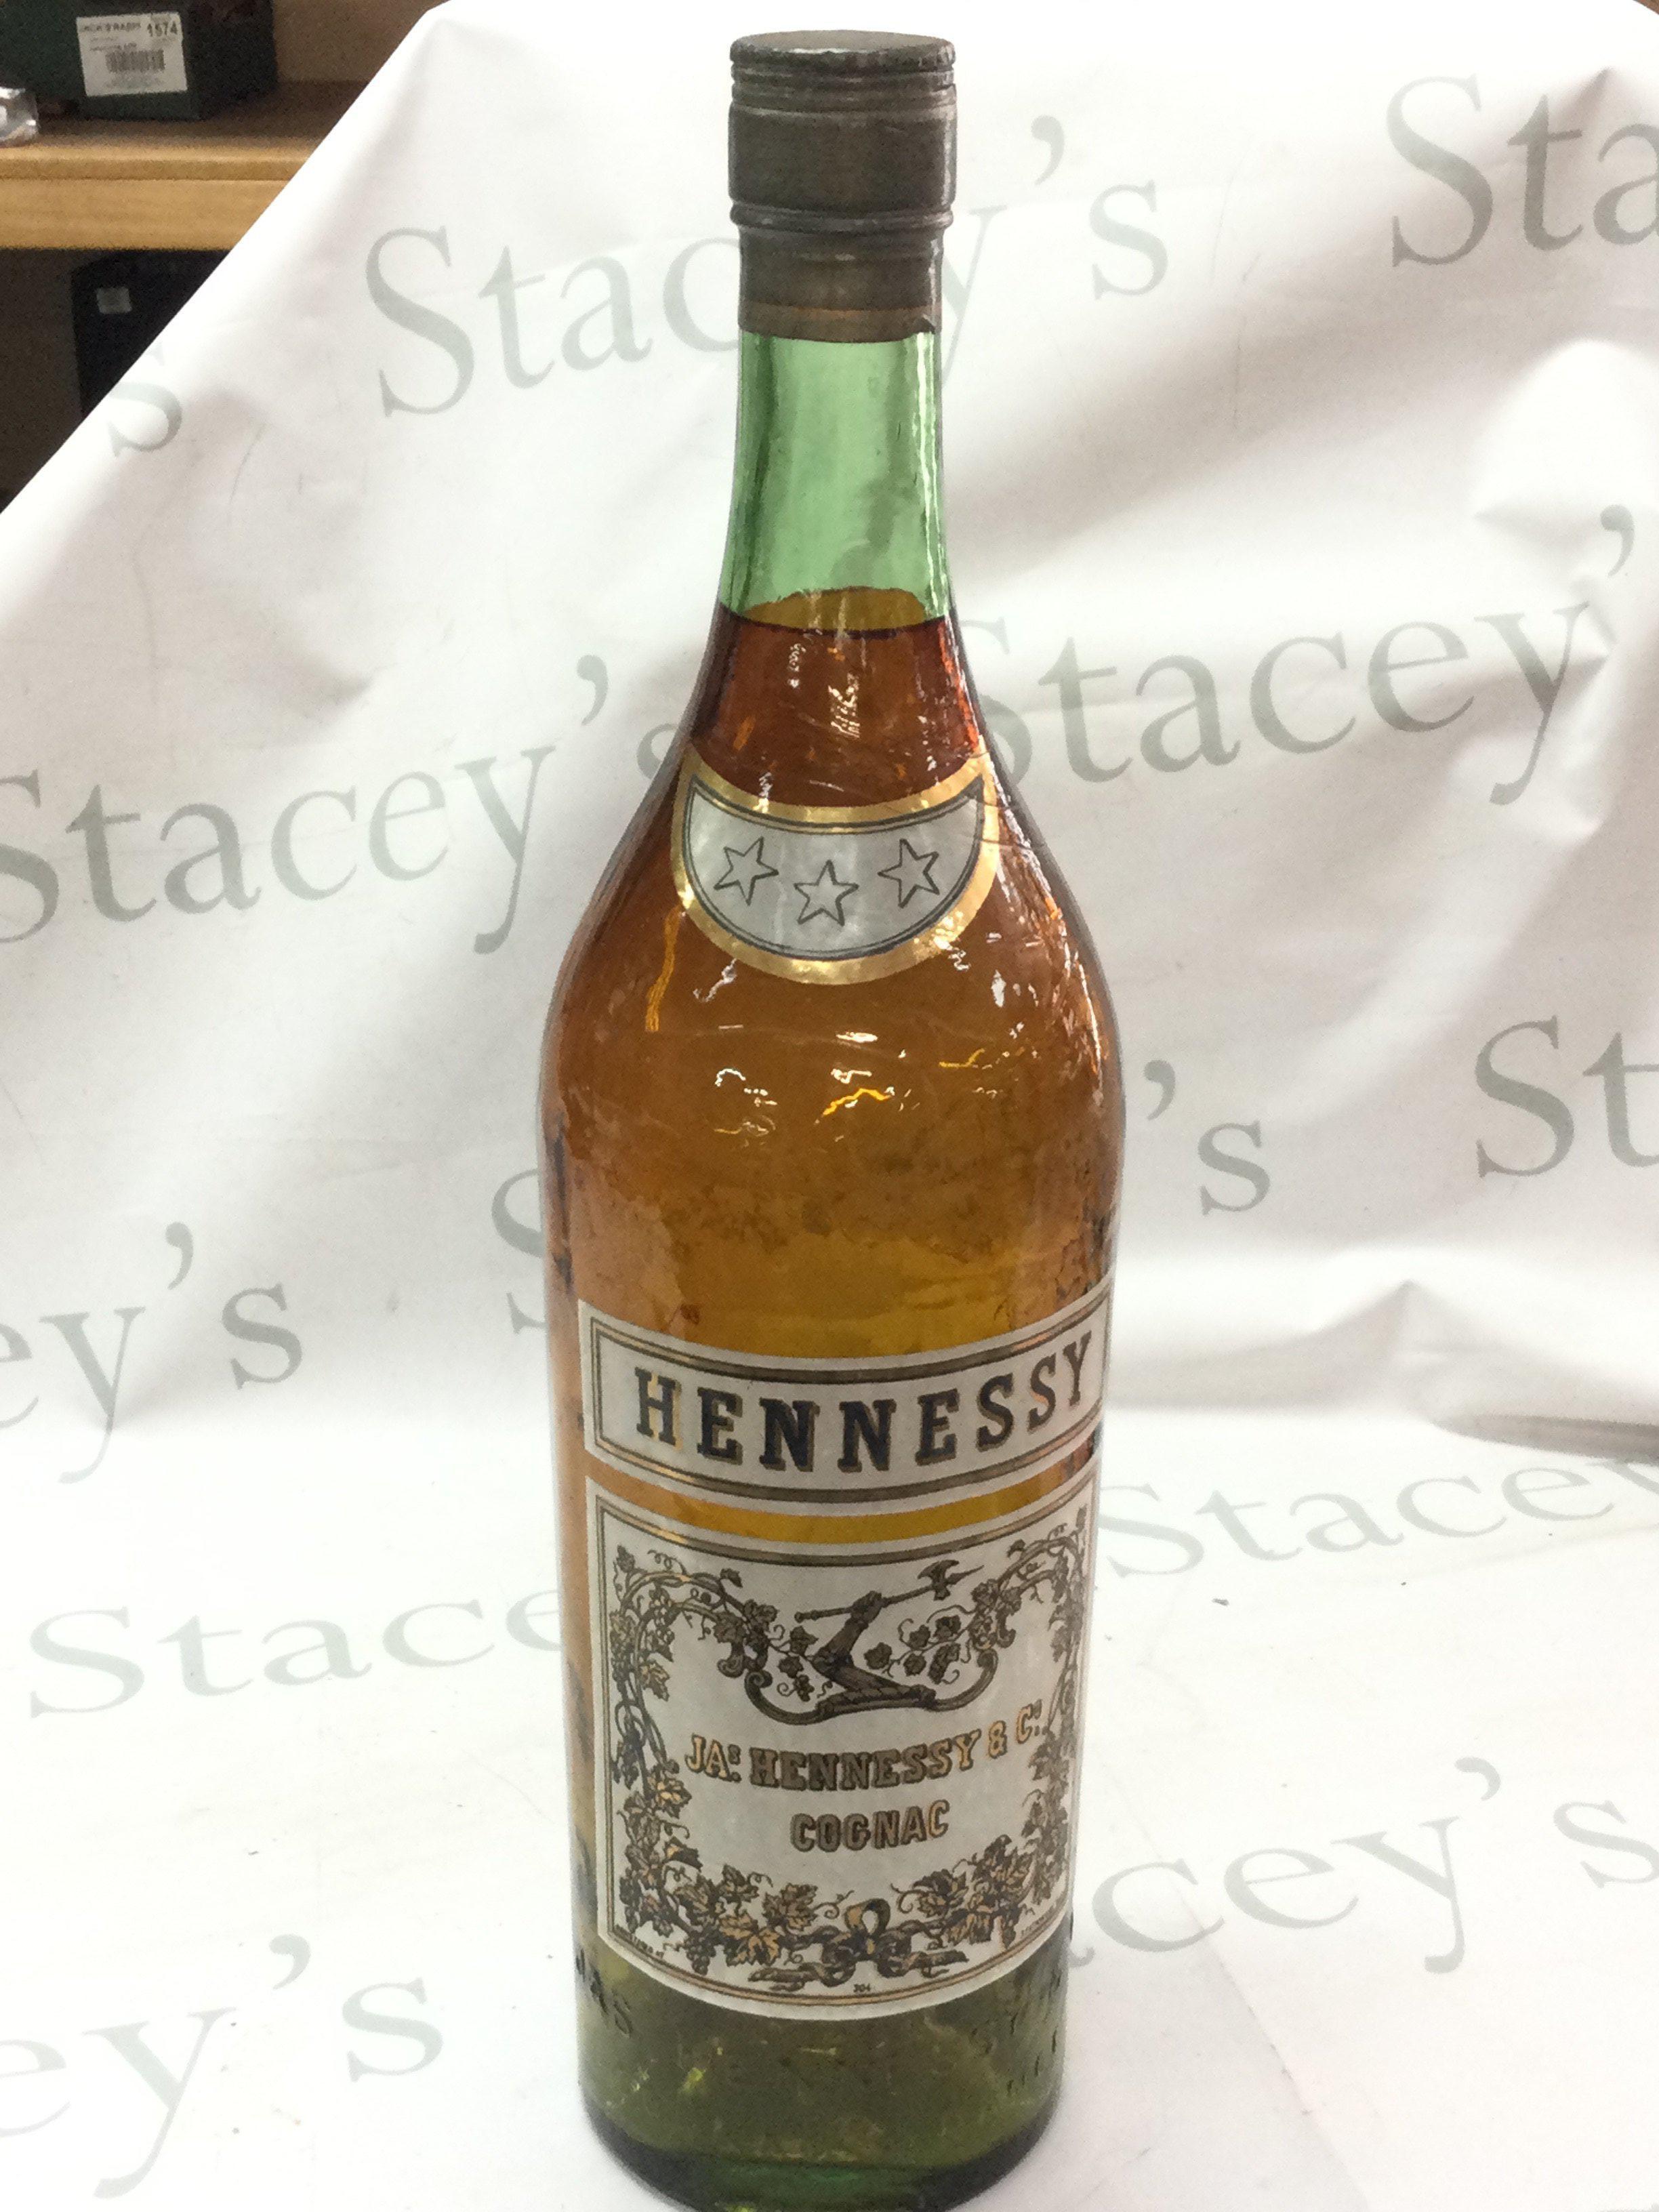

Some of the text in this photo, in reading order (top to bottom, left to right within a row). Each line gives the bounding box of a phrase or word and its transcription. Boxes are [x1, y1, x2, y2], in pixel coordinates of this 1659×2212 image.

[635, 1330, 1092, 1473] HENNESSY
[748, 1728, 982, 1791] HENNESSY
[988, 1719, 1008, 1759] &
[790, 1799, 950, 1853] COGNAC
